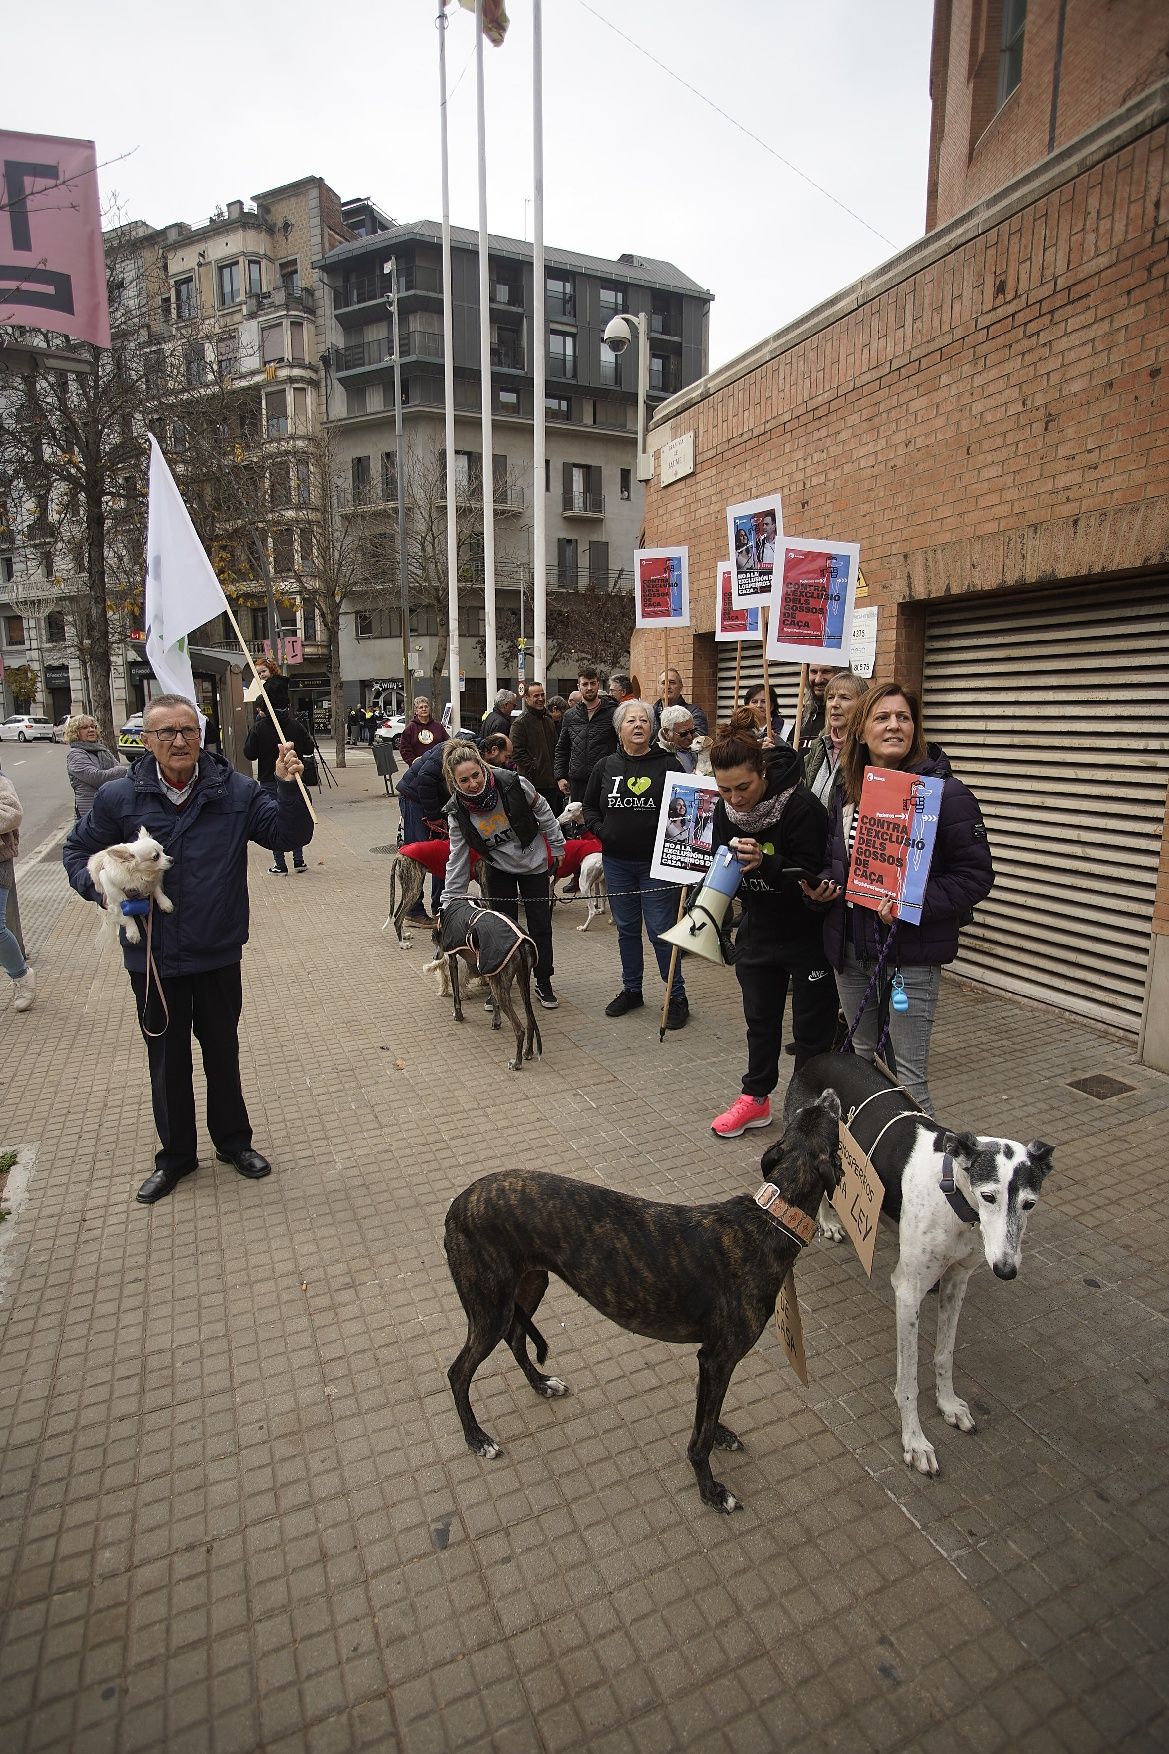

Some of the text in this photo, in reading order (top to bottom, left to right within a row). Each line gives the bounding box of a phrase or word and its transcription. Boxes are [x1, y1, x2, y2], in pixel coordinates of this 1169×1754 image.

[785, 583, 828, 592] CONTRA
[785, 590, 841, 601] L'EXCLUSIÓ
[785, 597, 810, 606] DELS
[783, 604, 825, 615] GOSSOS
[783, 611, 797, 619] DE
[782, 619, 811, 629] CAÇA
[607, 776, 623, 798] I
[607, 797, 656, 808] PACMA
[860, 814, 909, 836] CONTRA
[857, 836, 887, 851] DELS
[859, 825, 925, 850] L'EXCLUSIÓ
[663, 847, 703, 860] EXCLUSIÓN
[856, 846, 903, 867] GOSSOS
[662, 858, 681, 867] CAZA
[854, 857, 870, 869] DE
[853, 867, 884, 885] CAÇA
[850, 1193, 873, 1242] LEY
